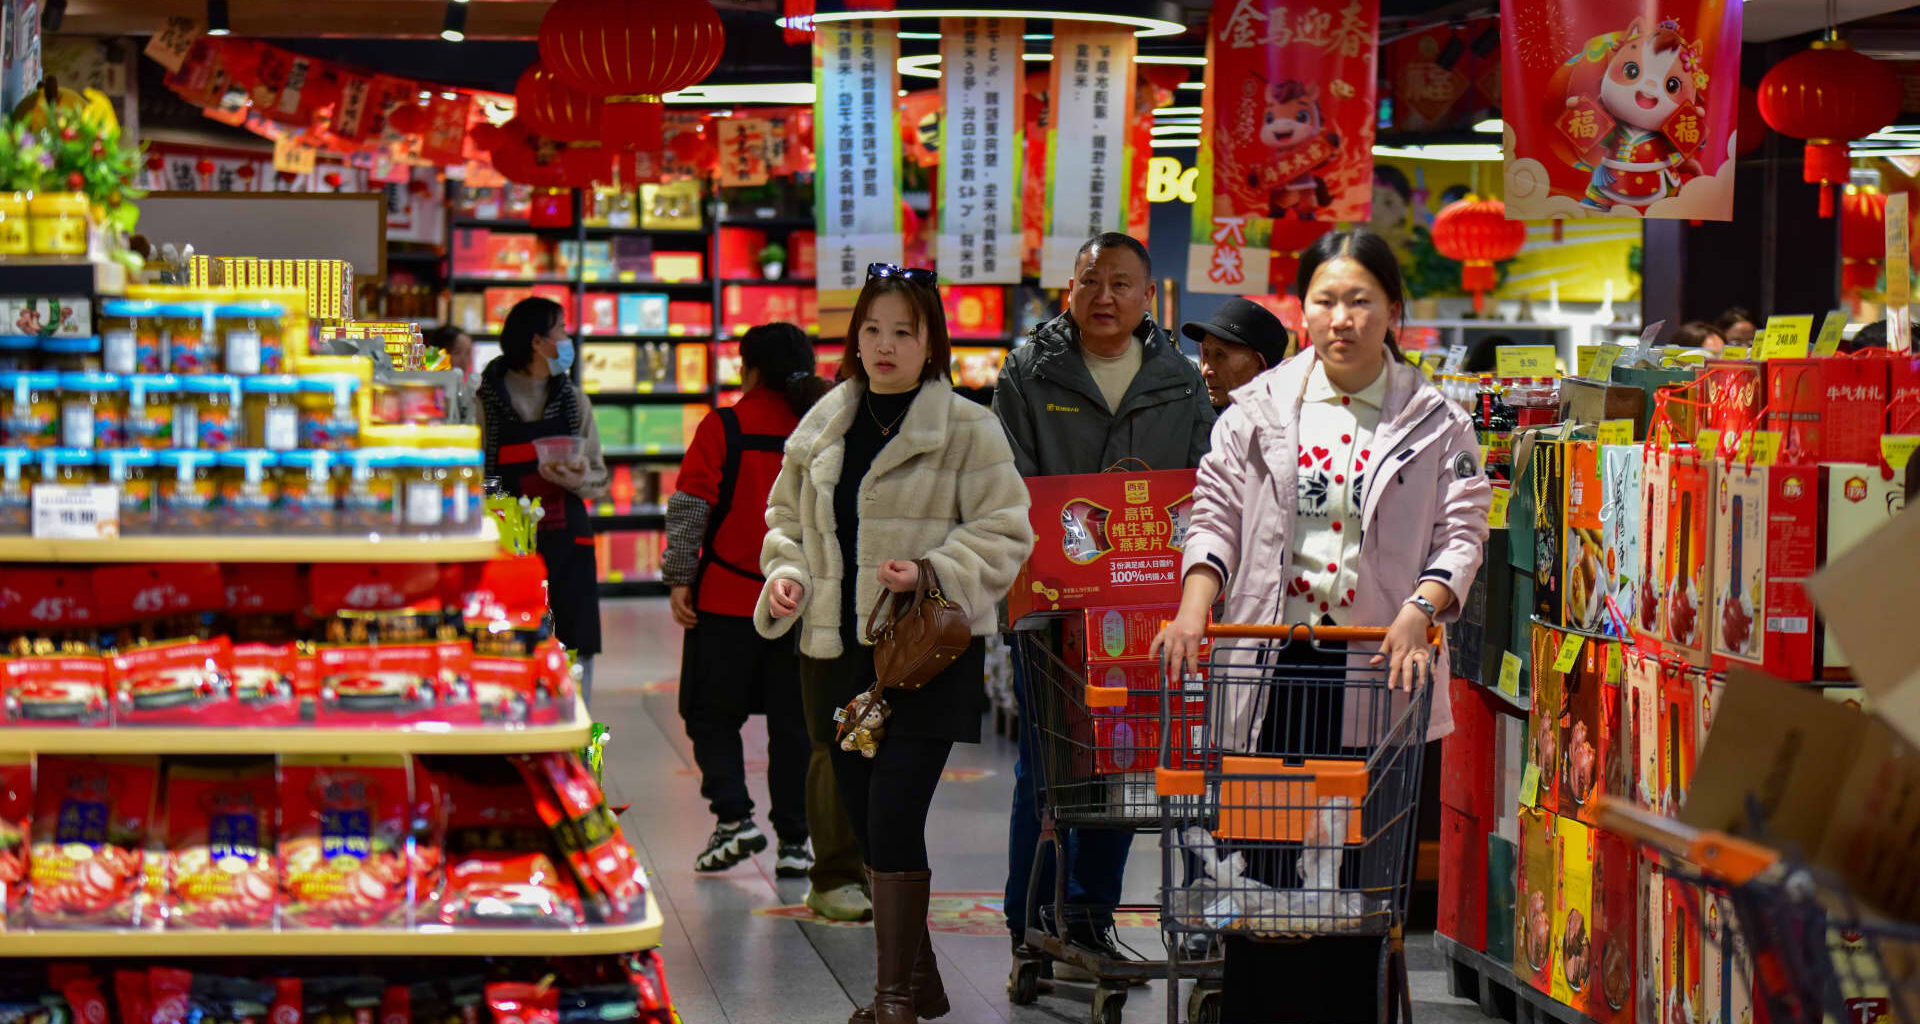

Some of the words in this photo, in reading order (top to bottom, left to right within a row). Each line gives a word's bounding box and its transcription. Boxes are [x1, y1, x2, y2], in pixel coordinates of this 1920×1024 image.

[1219, 0, 1373, 57] 金马迎春
[1567, 108, 1600, 140] 福
[1674, 114, 1700, 145] 福
[1826, 384, 1883, 402] 牛气有礼
[1124, 506, 1154, 521] 高钙
[1112, 521, 1167, 537] 维生素D
[1119, 537, 1163, 551] 燕麦片
